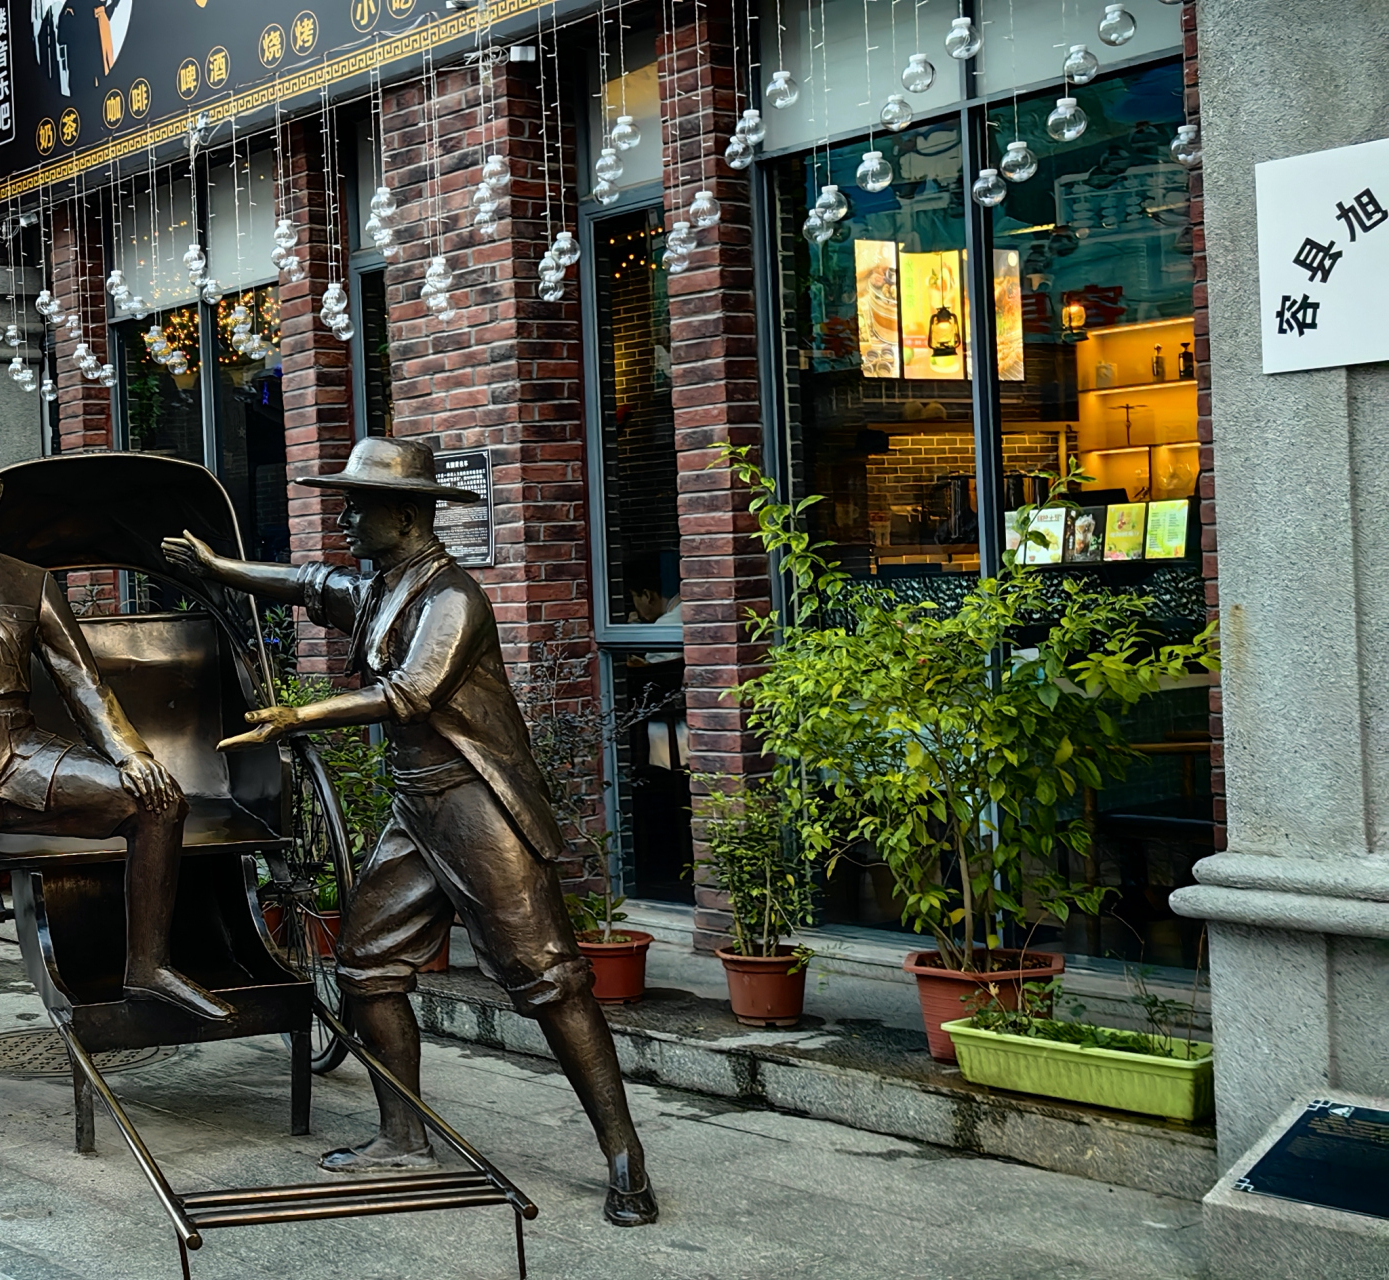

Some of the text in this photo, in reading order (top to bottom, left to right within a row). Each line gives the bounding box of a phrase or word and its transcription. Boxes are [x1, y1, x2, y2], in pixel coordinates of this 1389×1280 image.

[38, 113, 78, 150] 奶茶
[106, 83, 148, 122] 咖啡
[179, 50, 227, 93] 啤酒
[261, 17, 316, 63] 烧烤
